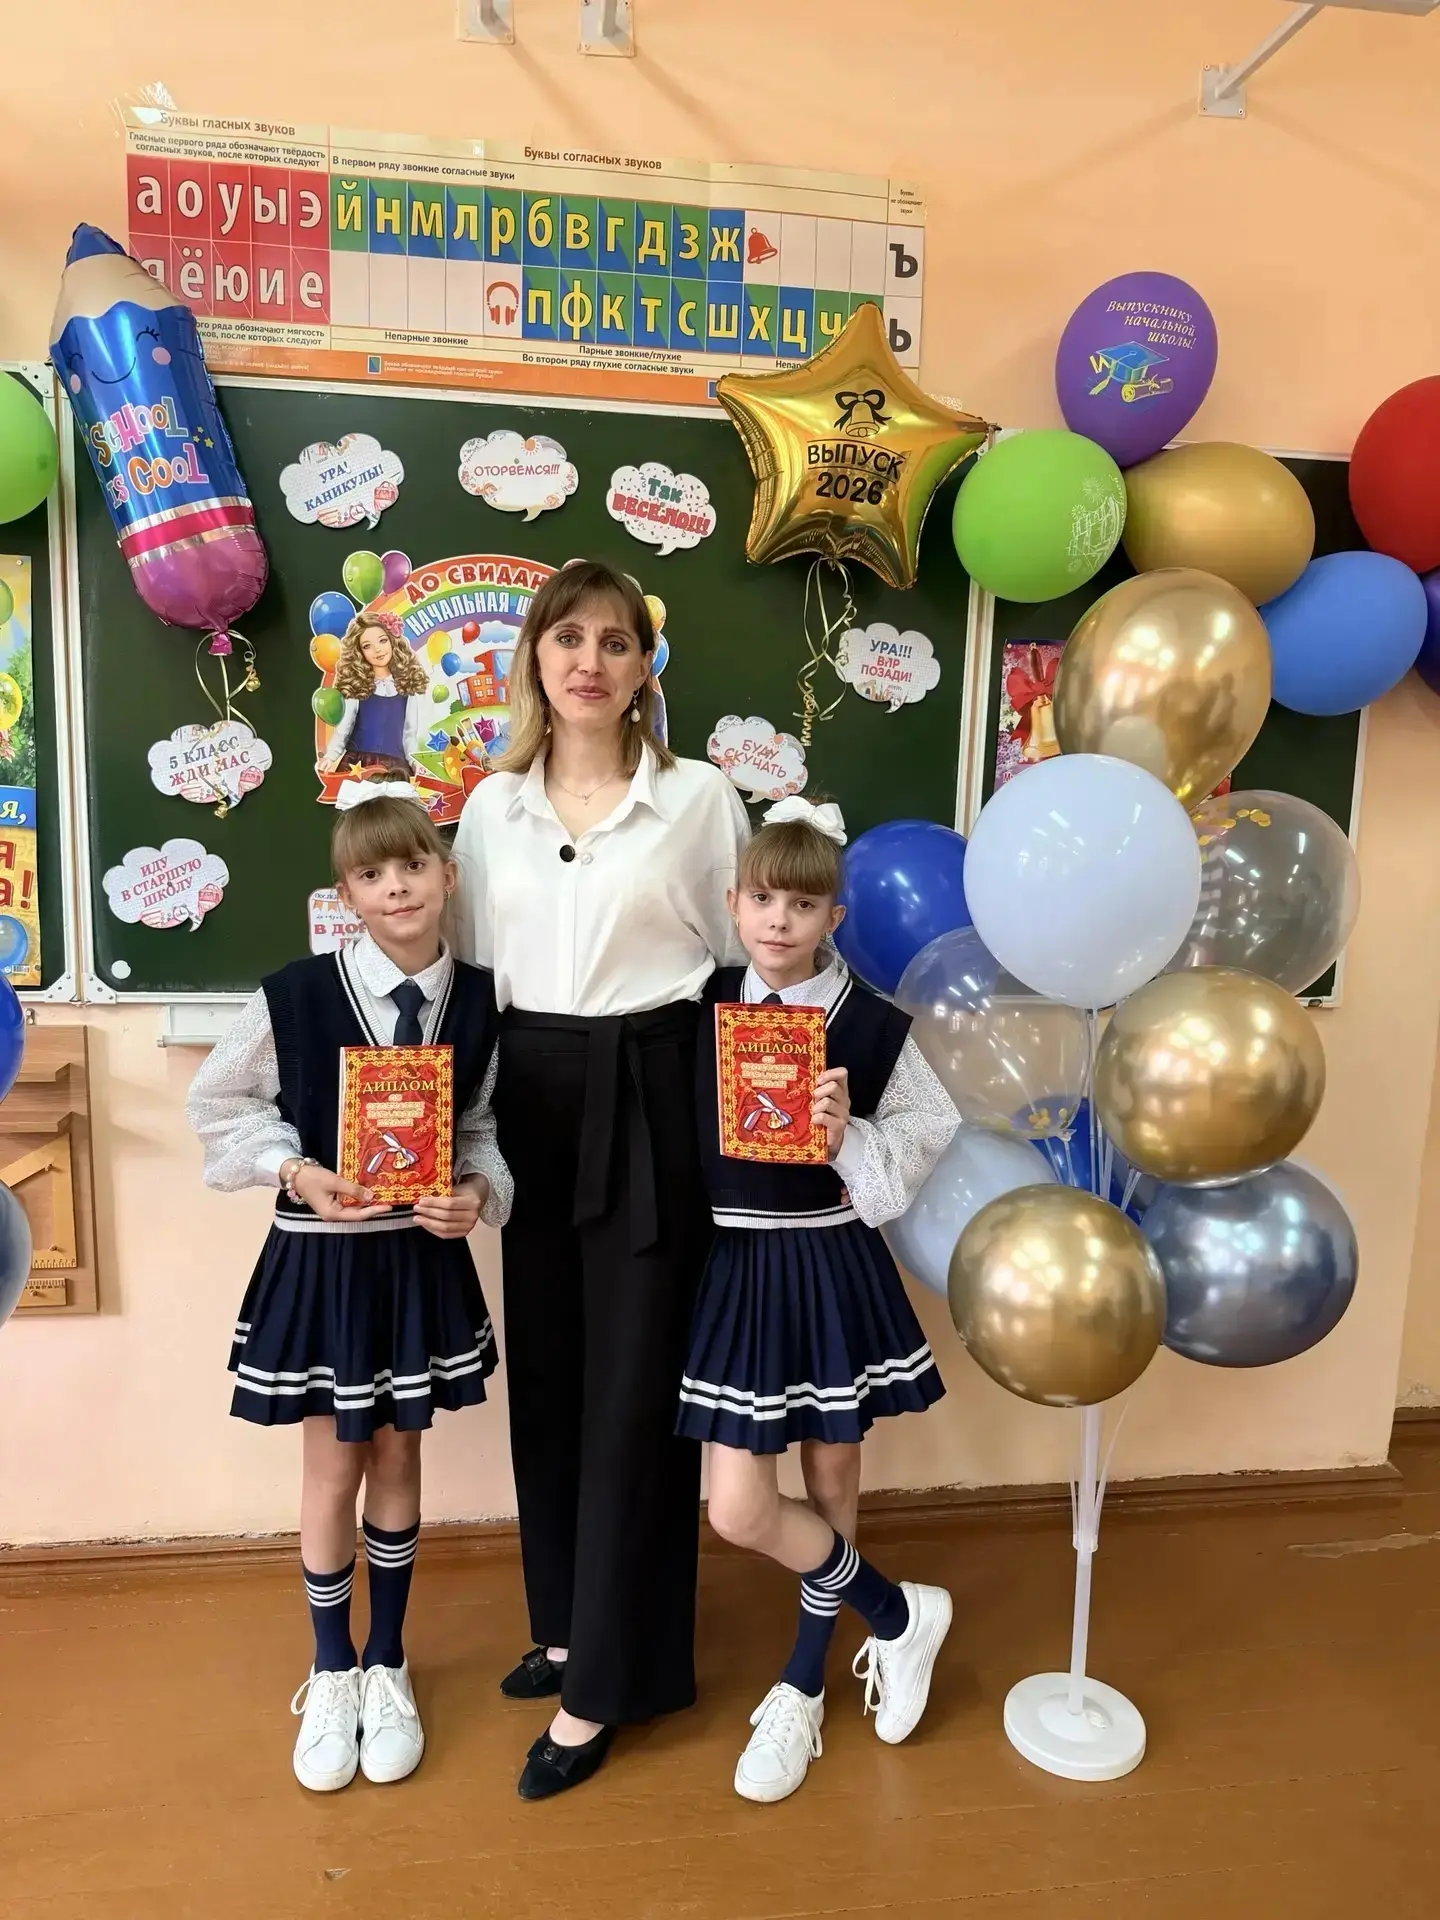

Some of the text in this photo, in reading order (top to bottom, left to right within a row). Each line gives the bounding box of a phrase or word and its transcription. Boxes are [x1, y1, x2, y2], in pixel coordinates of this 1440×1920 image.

[160, 112, 296, 136] Буквы гласных звуков
[129, 132, 326, 160] Гласные первого ряда обозначают твёрдость
[136, 143, 320, 168] согласных звуков, после которых следуют
[524, 146, 662, 170] Буквы согласных звуков
[332, 156, 515, 180] В первом ряду звонкие согласные звуки
[136, 175, 163, 217] а
[178, 178, 204, 219] о
[217, 181, 244, 236] у
[254, 184, 288, 226] ы
[299, 190, 323, 229] э
[336, 180, 364, 232] й
[375, 197, 402, 236] н
[410, 200, 444, 239] м
[452, 204, 479, 242] л
[490, 206, 516, 257] р
[528, 198, 554, 249] б
[564, 213, 590, 251] в
[605, 216, 626, 253] г
[638, 219, 667, 266] д
[678, 224, 700, 260] з
[710, 226, 741, 264] ж
[180, 246, 205, 300] ё
[214, 264, 250, 303] ю
[259, 266, 286, 306] и
[300, 271, 324, 308] е
[527, 288, 552, 326] п
[561, 279, 594, 342] ф
[602, 294, 626, 331] к
[640, 296, 663, 333] т
[678, 300, 696, 338] с
[708, 303, 738, 340] ш
[748, 306, 772, 342] х
[782, 308, 808, 355] ц
[820, 311, 843, 337] ч
[1106, 300, 1193, 324] Выпускнику
[212, 323, 232, 332] ряда
[234, 324, 285, 334] обозначают
[287, 328, 325, 338] мягкость
[1124, 315, 1196, 337] начальной
[221, 332, 246, 341] после
[248, 334, 284, 344] которых
[286, 337, 322, 346] следуют
[384, 331, 469, 346] Непарные звонкие
[1147, 332, 1197, 350] школы!
[522, 354, 694, 376] Во втором ряду глухие согласные звуки
[579, 345, 682, 362] Парные звонкие/глухие
[90, 396, 189, 468] SCHOOL
[319, 462, 350, 484] УРА!
[808, 444, 904, 480] ВЫПУСК
[106, 443, 209, 510] IS COOL
[304, 464, 384, 512] КАНИКУЛЫ!
[816, 472, 884, 506] 2026
[406, 574, 440, 605] ДО
[405, 592, 510, 636] НАЧАЛЬНАЯ
[870, 639, 912, 658] УРА!!!
[860, 664, 912, 682] ПОЗАДИ!
[169, 736, 240, 770] 5 КЛАСС
[742, 740, 780, 760] БУДУ
[169, 751, 250, 787] ЖДИ НАС
[724, 748, 786, 778] СКУЧАТЬ
[140, 856, 168, 877] ИДУ
[121, 858, 202, 902] В СТАРШУЮ
[142, 876, 193, 908] ШКОЛУ
[314, 924, 326, 934] В
[736, 1042, 808, 1054] ДИПЛОМ
[362, 1080, 436, 1094] ДИПЛОМ
